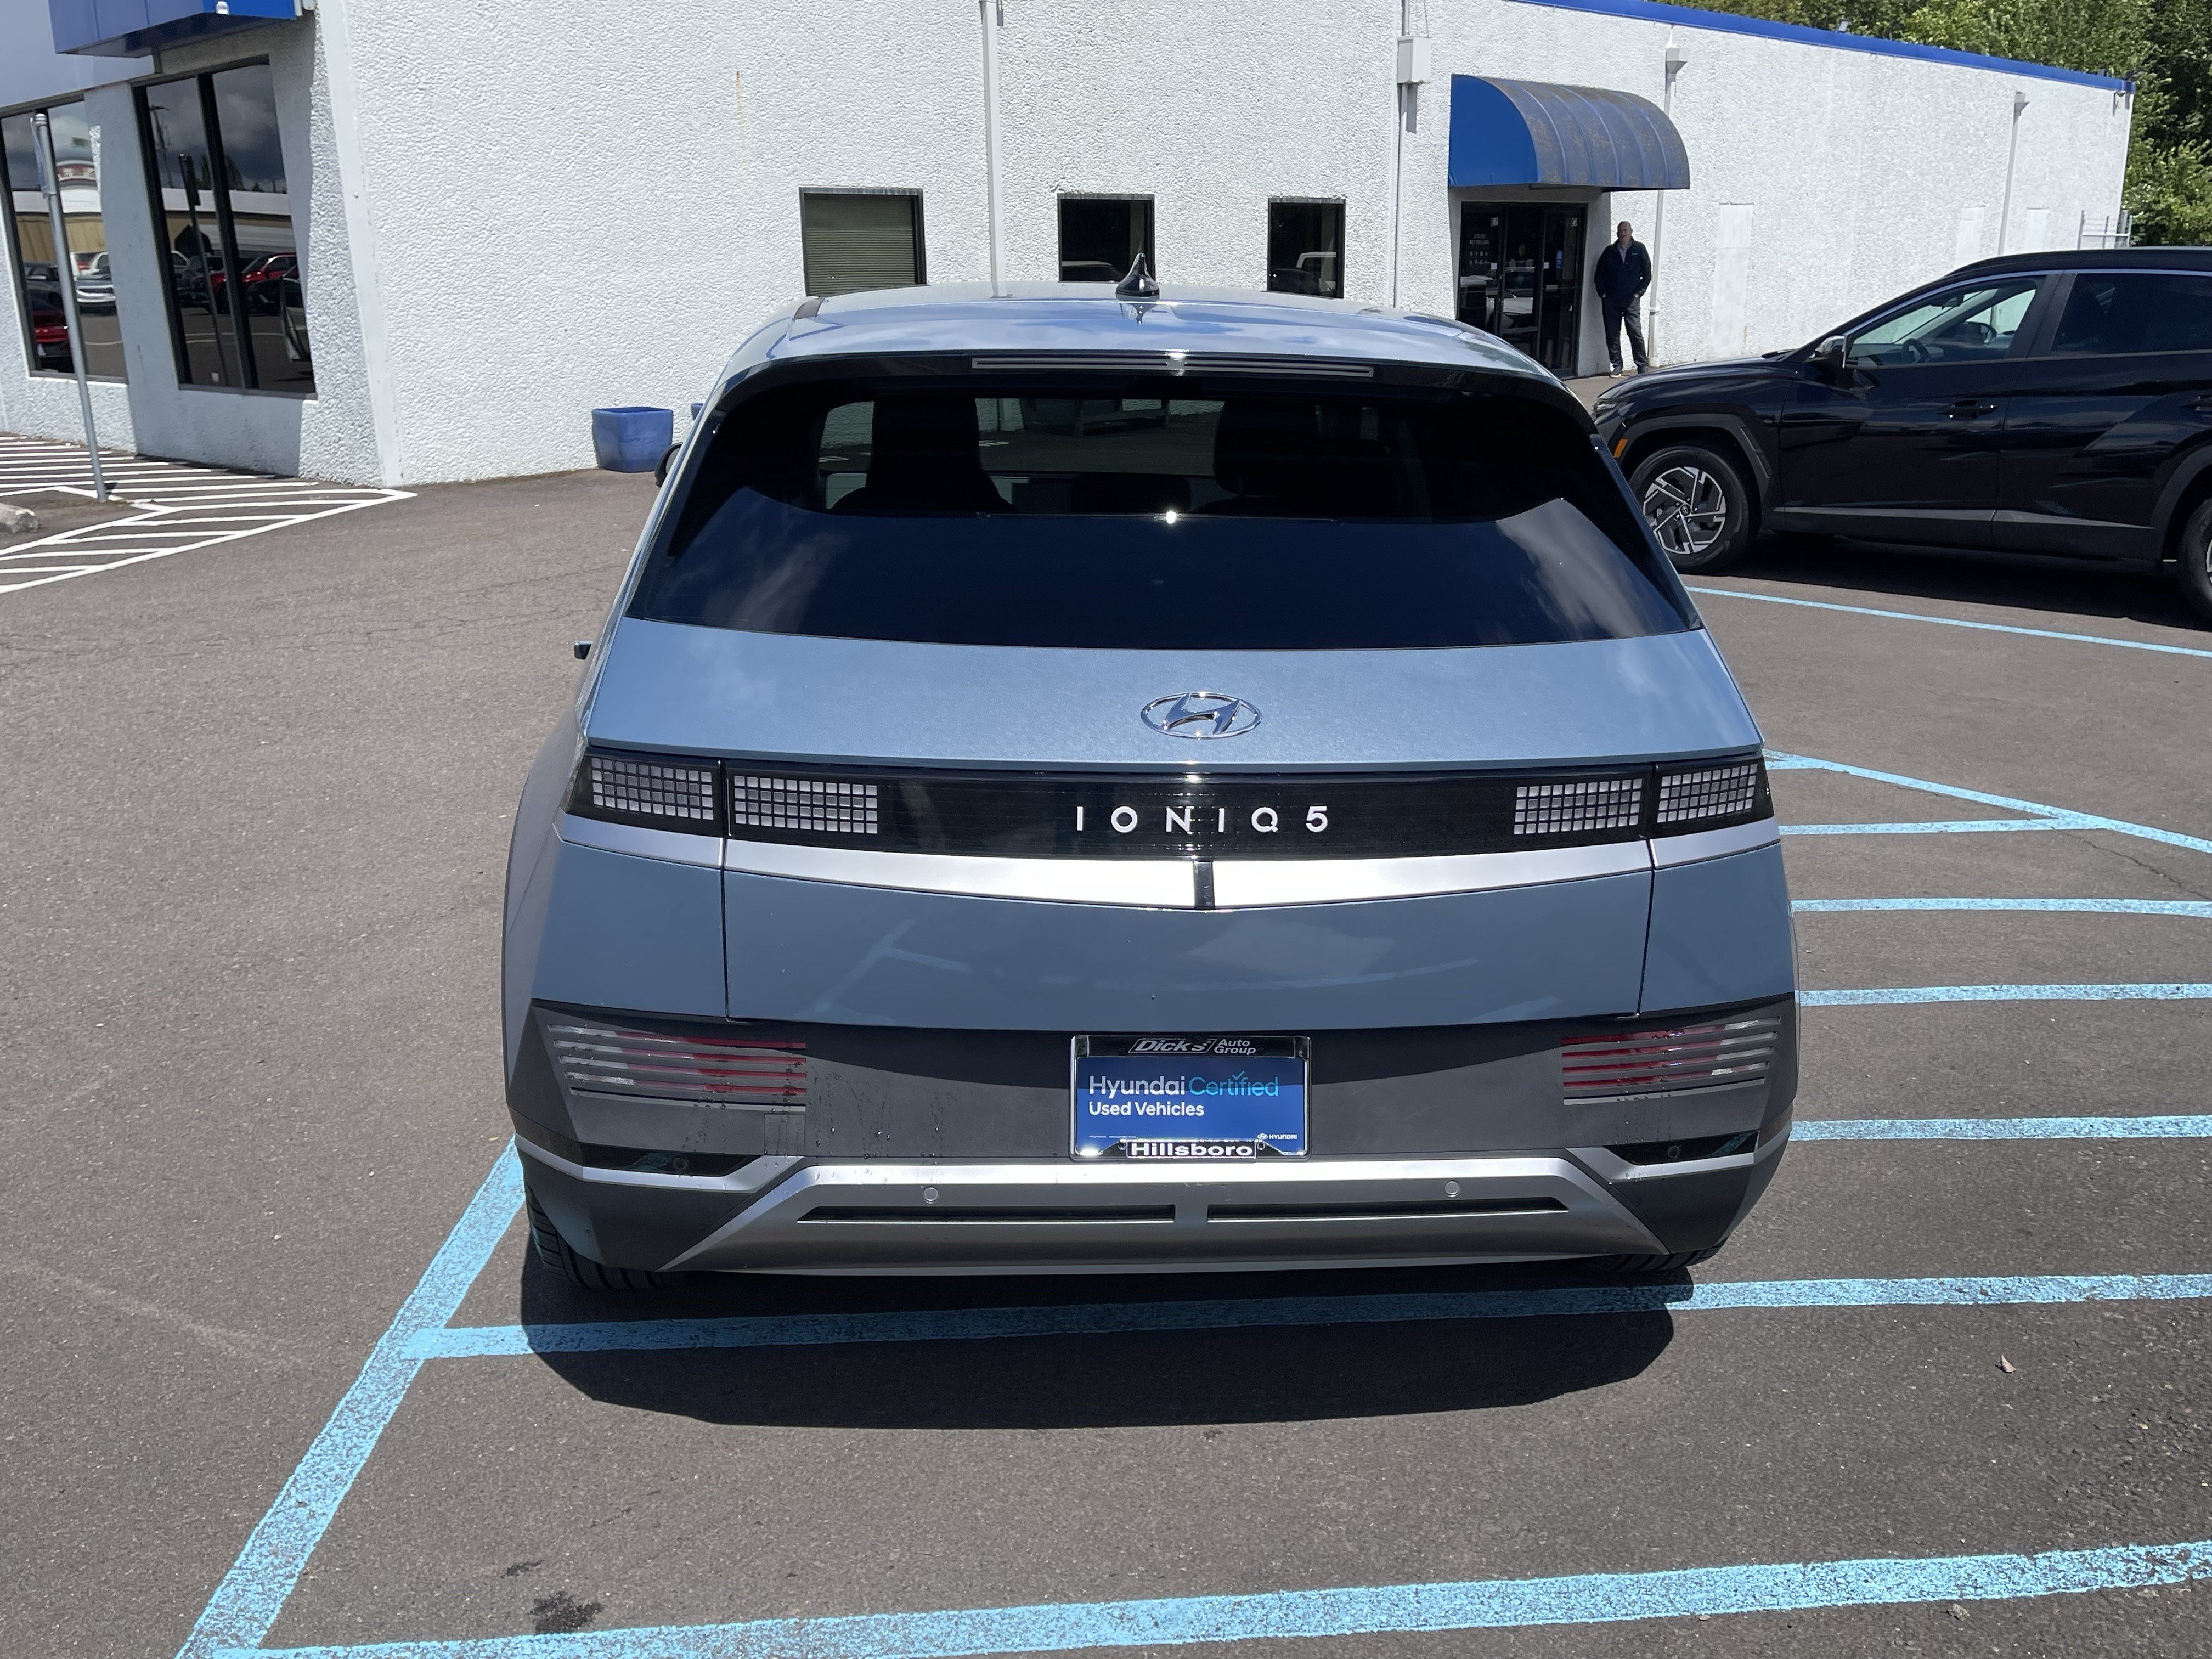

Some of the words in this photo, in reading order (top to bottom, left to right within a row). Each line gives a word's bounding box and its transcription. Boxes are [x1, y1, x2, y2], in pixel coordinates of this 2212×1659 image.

[1134, 1039, 1208, 1052] Dicks
[1217, 1039, 1250, 1047] Auto
[1214, 1046, 1256, 1055] Group
[1088, 1075, 1186, 1099] Hyundai
[1188, 1072, 1278, 1096] Certified
[1088, 1101, 1131, 1116] Used
[1134, 1101, 1205, 1116] Vehicles
[1131, 1143, 1254, 1156] Hillsboro
